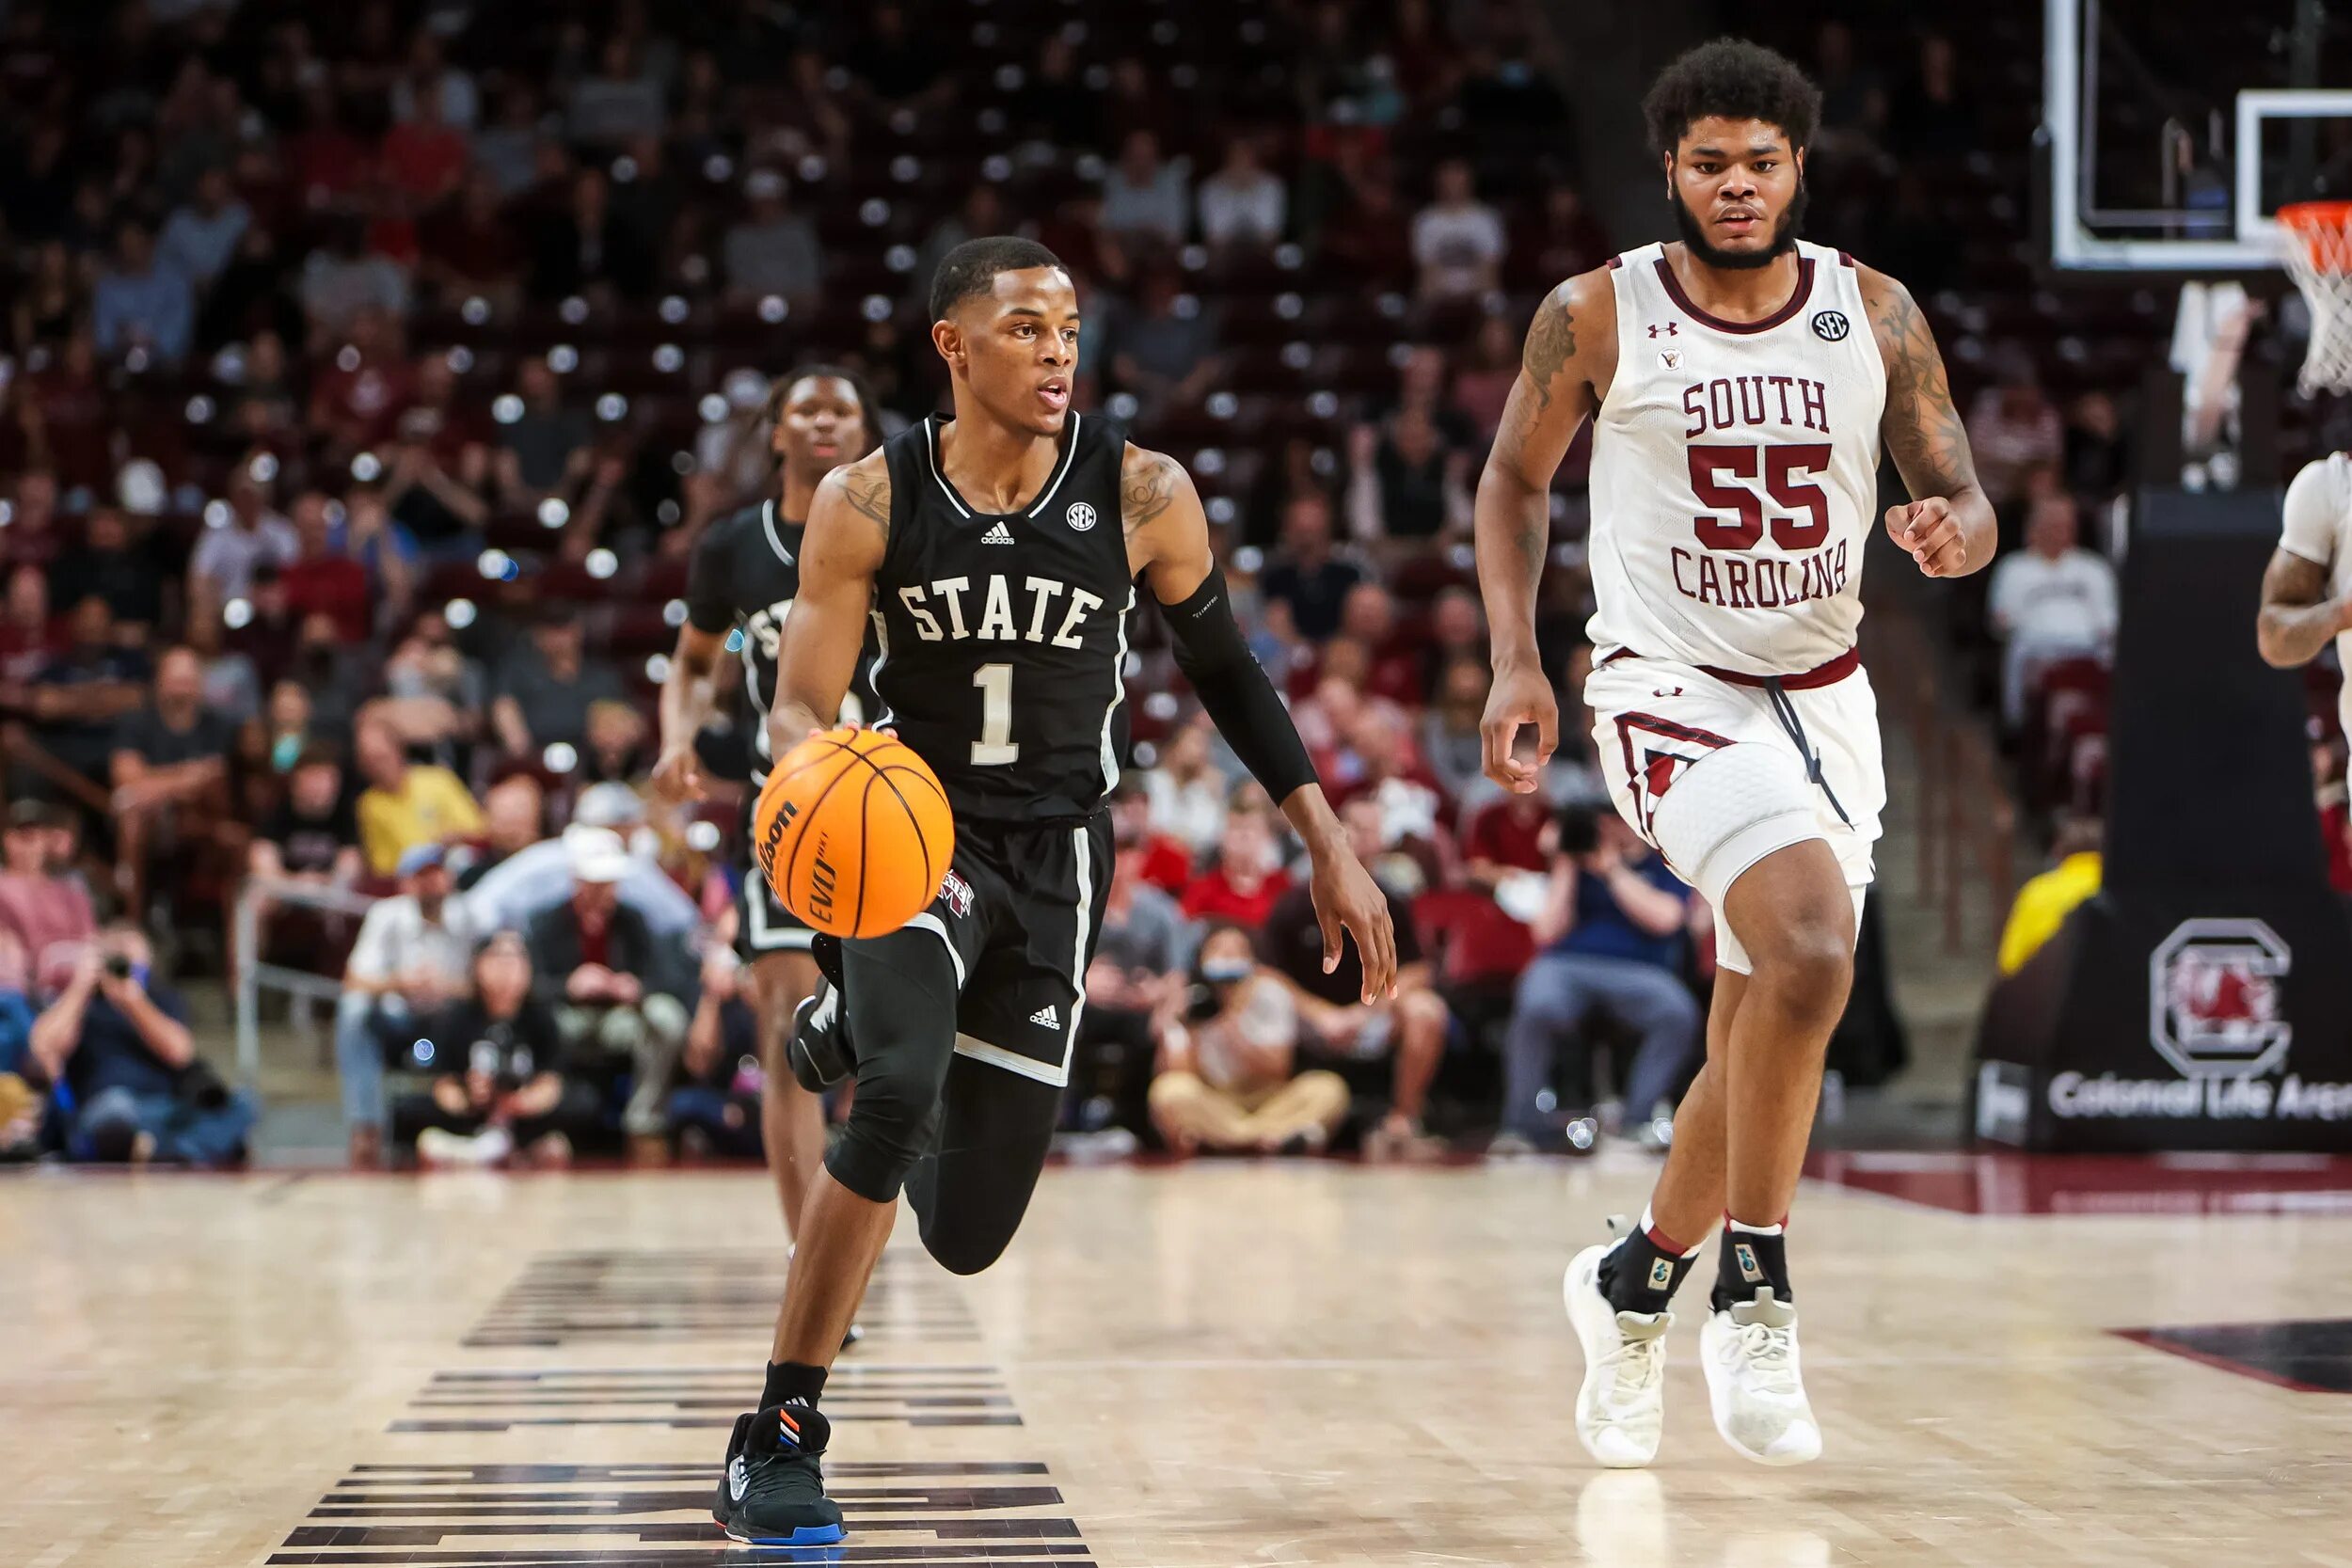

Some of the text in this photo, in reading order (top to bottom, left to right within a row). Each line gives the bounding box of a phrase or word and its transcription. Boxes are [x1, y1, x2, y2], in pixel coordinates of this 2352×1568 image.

[1814, 312, 1848, 341] SEC
[1683, 376, 1830, 439] SOUTH
[1069, 503, 1094, 530] SEC
[1687, 443, 1833, 550] 55
[980, 535, 1015, 546] adidas
[1671, 538, 1847, 609] CAROLINA
[898, 574, 1104, 650] STATE
[970, 662, 1019, 766] 1
[809, 858, 836, 925] EVO
[1029, 1015, 1060, 1030] adidas
